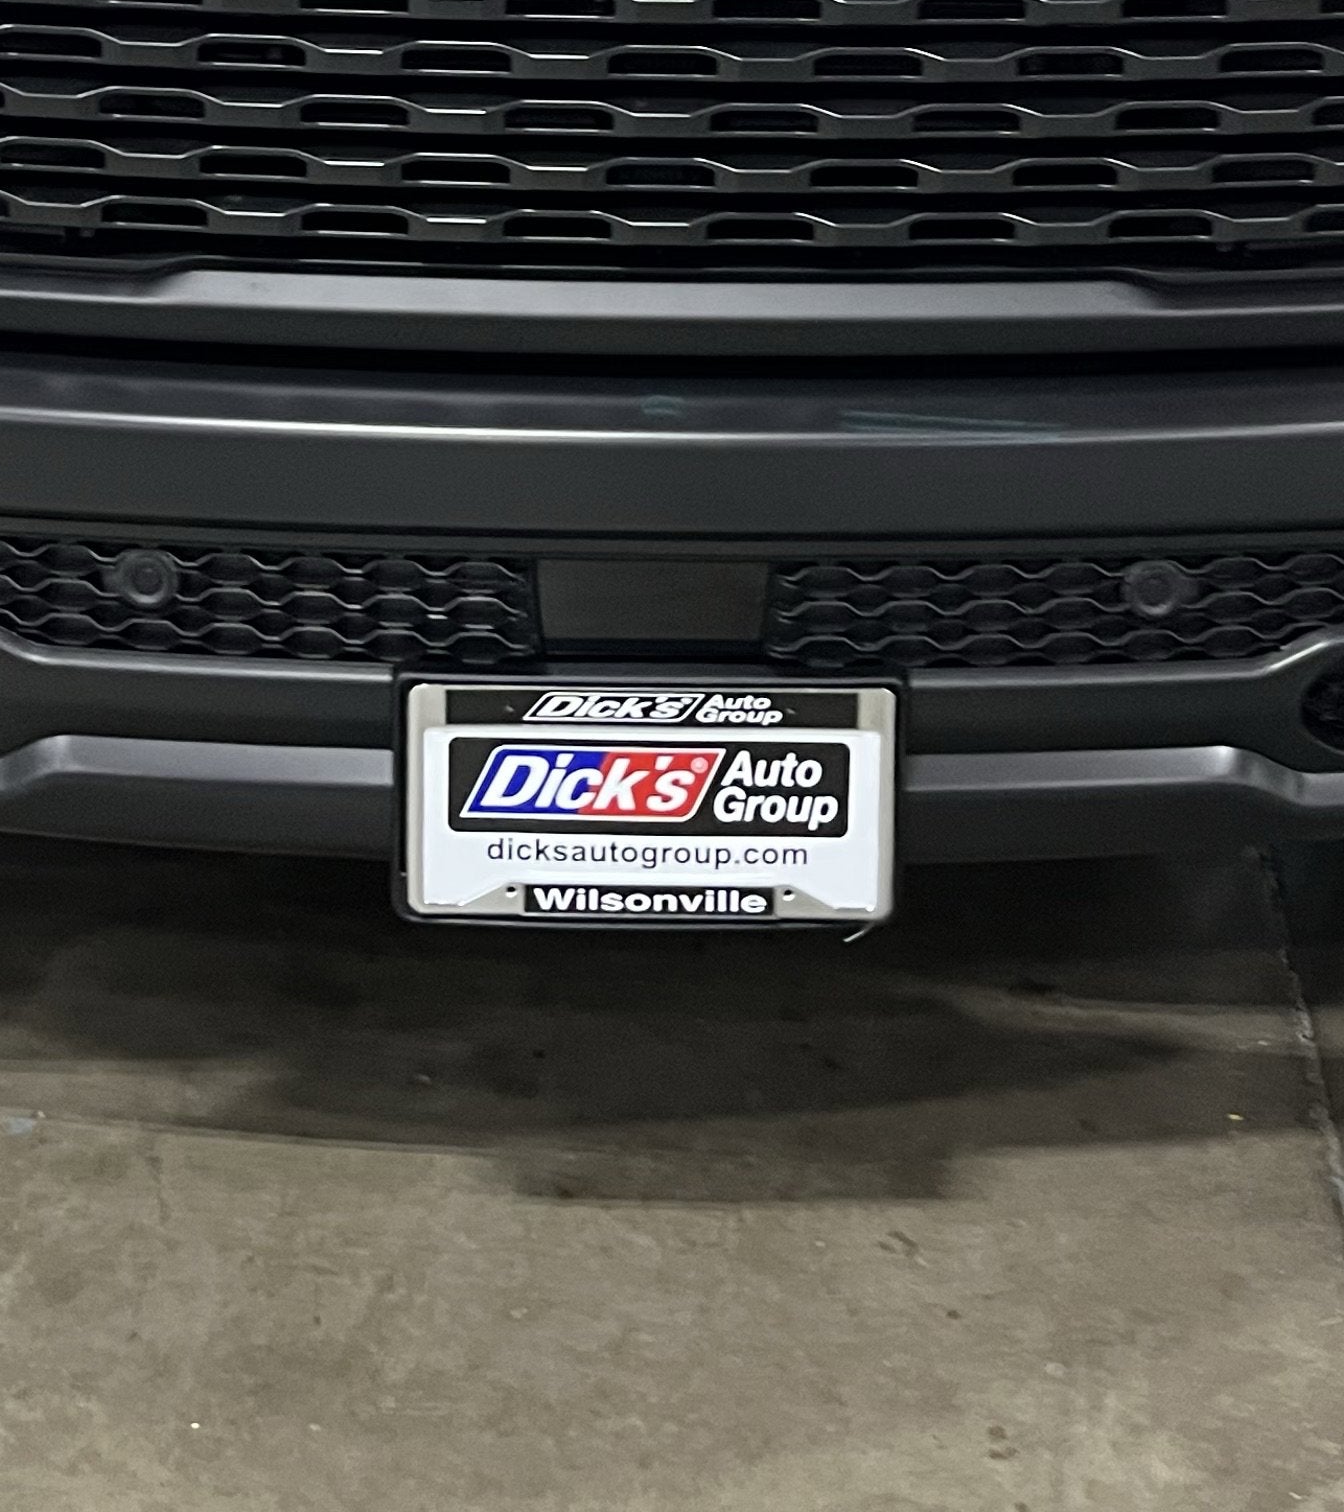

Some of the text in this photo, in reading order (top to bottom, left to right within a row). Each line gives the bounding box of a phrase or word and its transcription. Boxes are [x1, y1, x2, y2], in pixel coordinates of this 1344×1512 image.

[535, 694, 772, 720] Dick's Auto
[695, 707, 784, 726] Group
[478, 749, 823, 812] Dick's Auto
[713, 789, 840, 831] Group
[487, 838, 809, 869] dicksautogroup.com
[533, 886, 768, 915] Wilsonville
